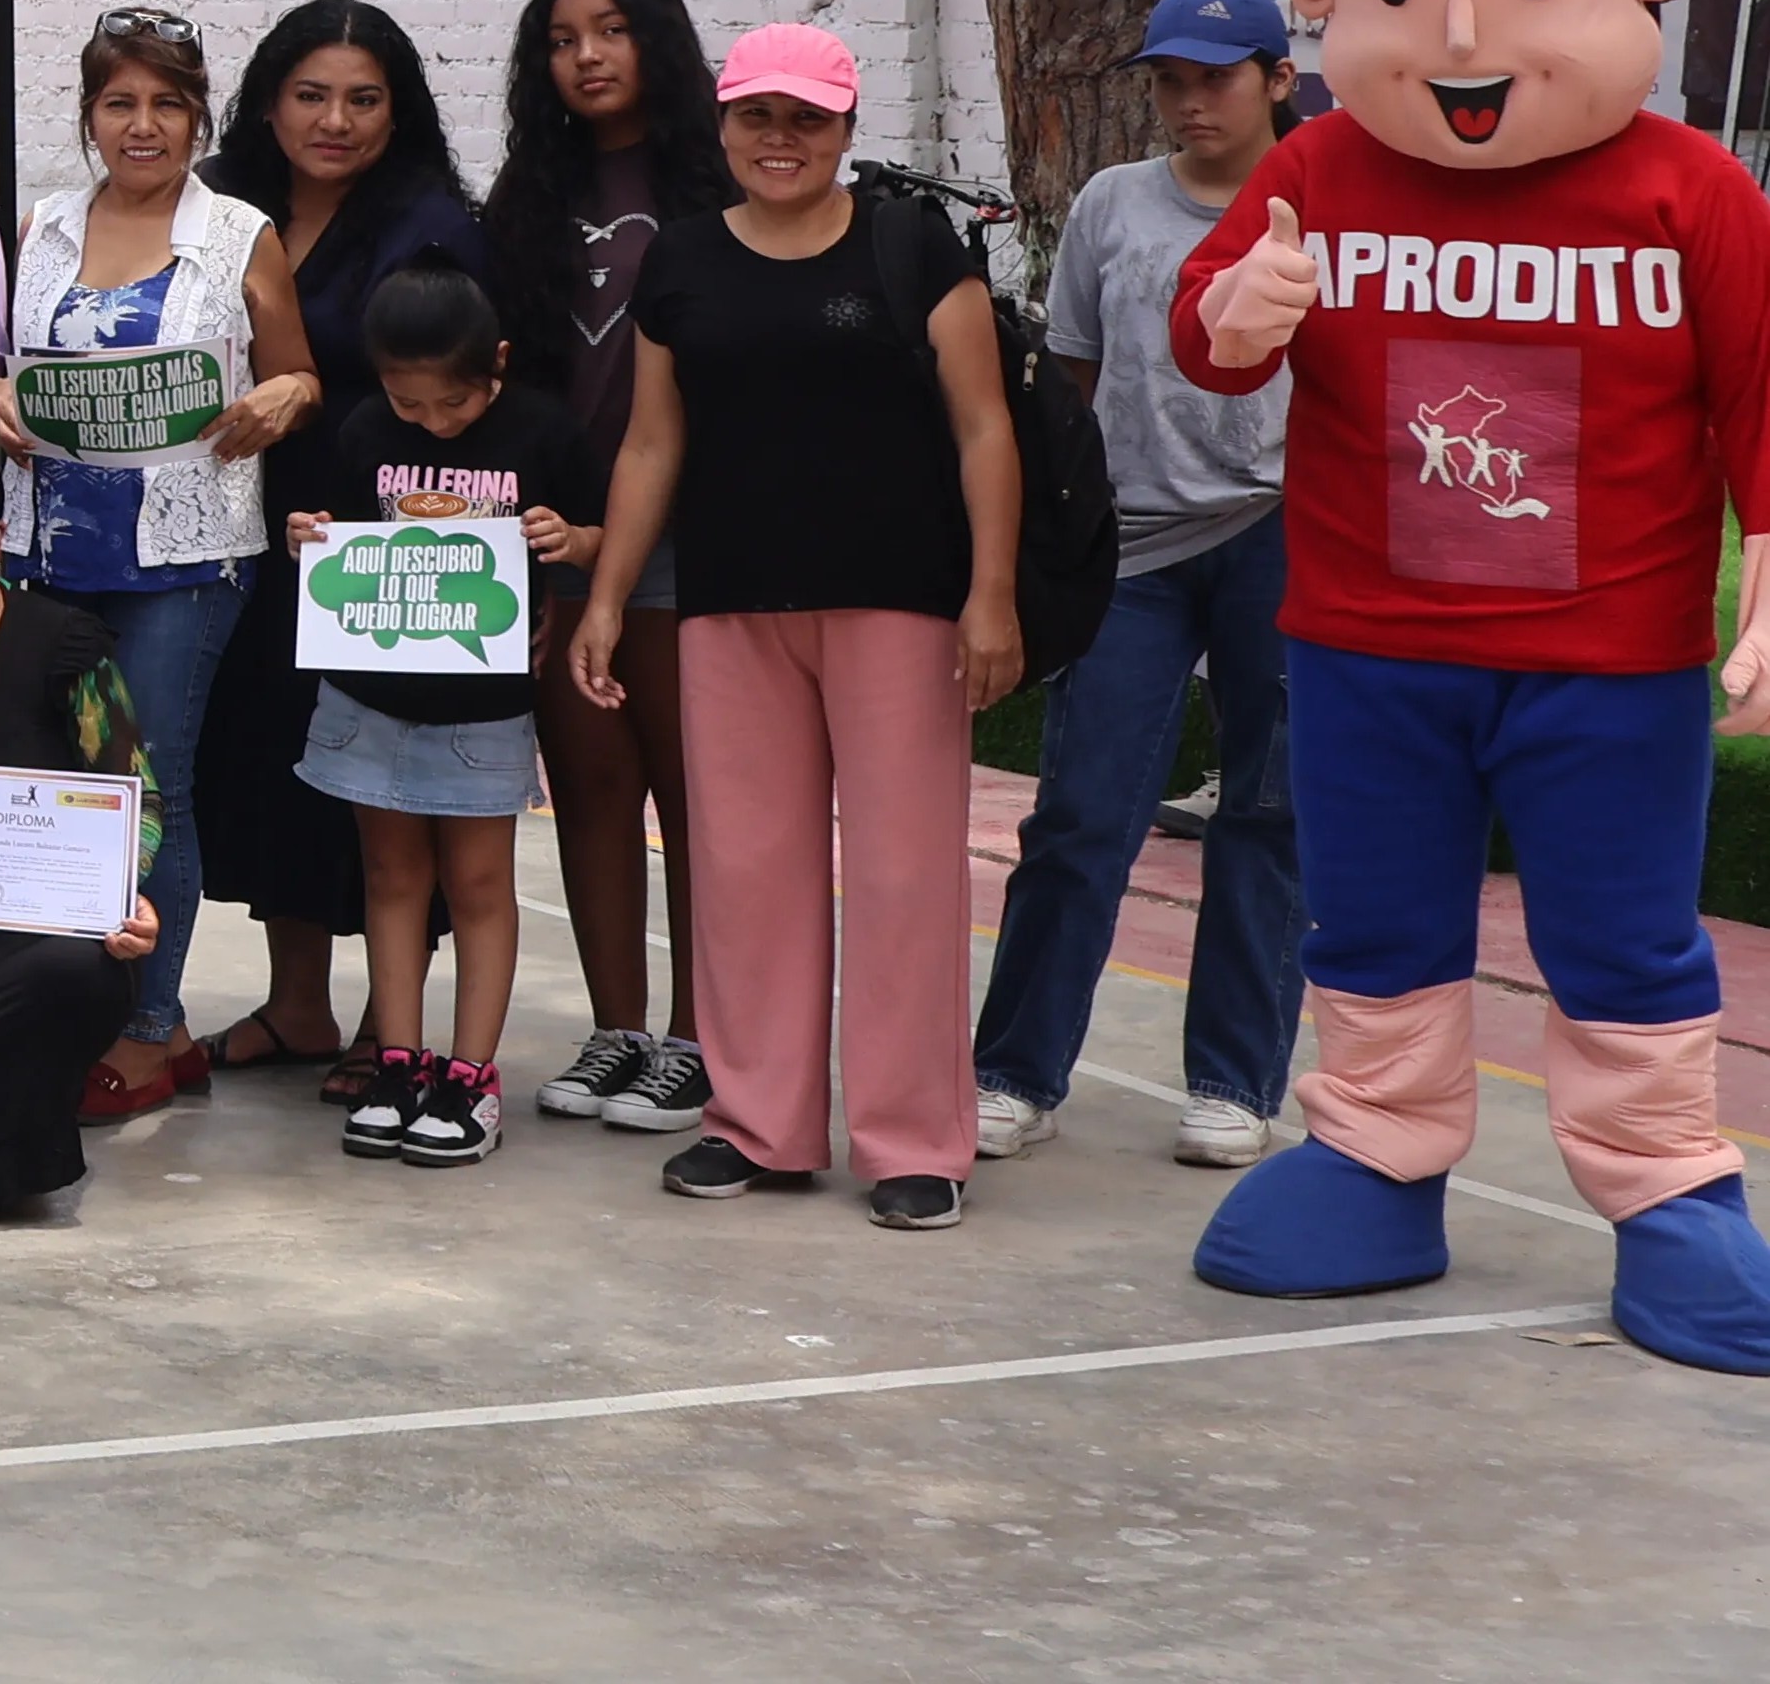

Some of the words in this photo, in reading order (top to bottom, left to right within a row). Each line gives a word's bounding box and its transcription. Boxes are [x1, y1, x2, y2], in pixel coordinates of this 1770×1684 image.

[1197, 9, 1232, 20] adidas
[1300, 231, 1682, 328] APRODITO
[34, 369, 55, 394] TU
[61, 366, 138, 396] ESFUERZO
[142, 363, 162, 389] ES
[166, 351, 203, 385] MÁS
[23, 394, 90, 422] VALIOSO
[95, 394, 127, 423] QUE
[131, 379, 219, 421] CUALQUIER
[78, 419, 168, 449] RESULTADO
[342, 542, 388, 574] AQUÍ
[391, 544, 483, 573] DESCUBRO
[378, 575, 400, 602] LO
[405, 574, 438, 603] QUE
[342, 603, 400, 630] PUEDO
[406, 603, 477, 631] LOGRAR
